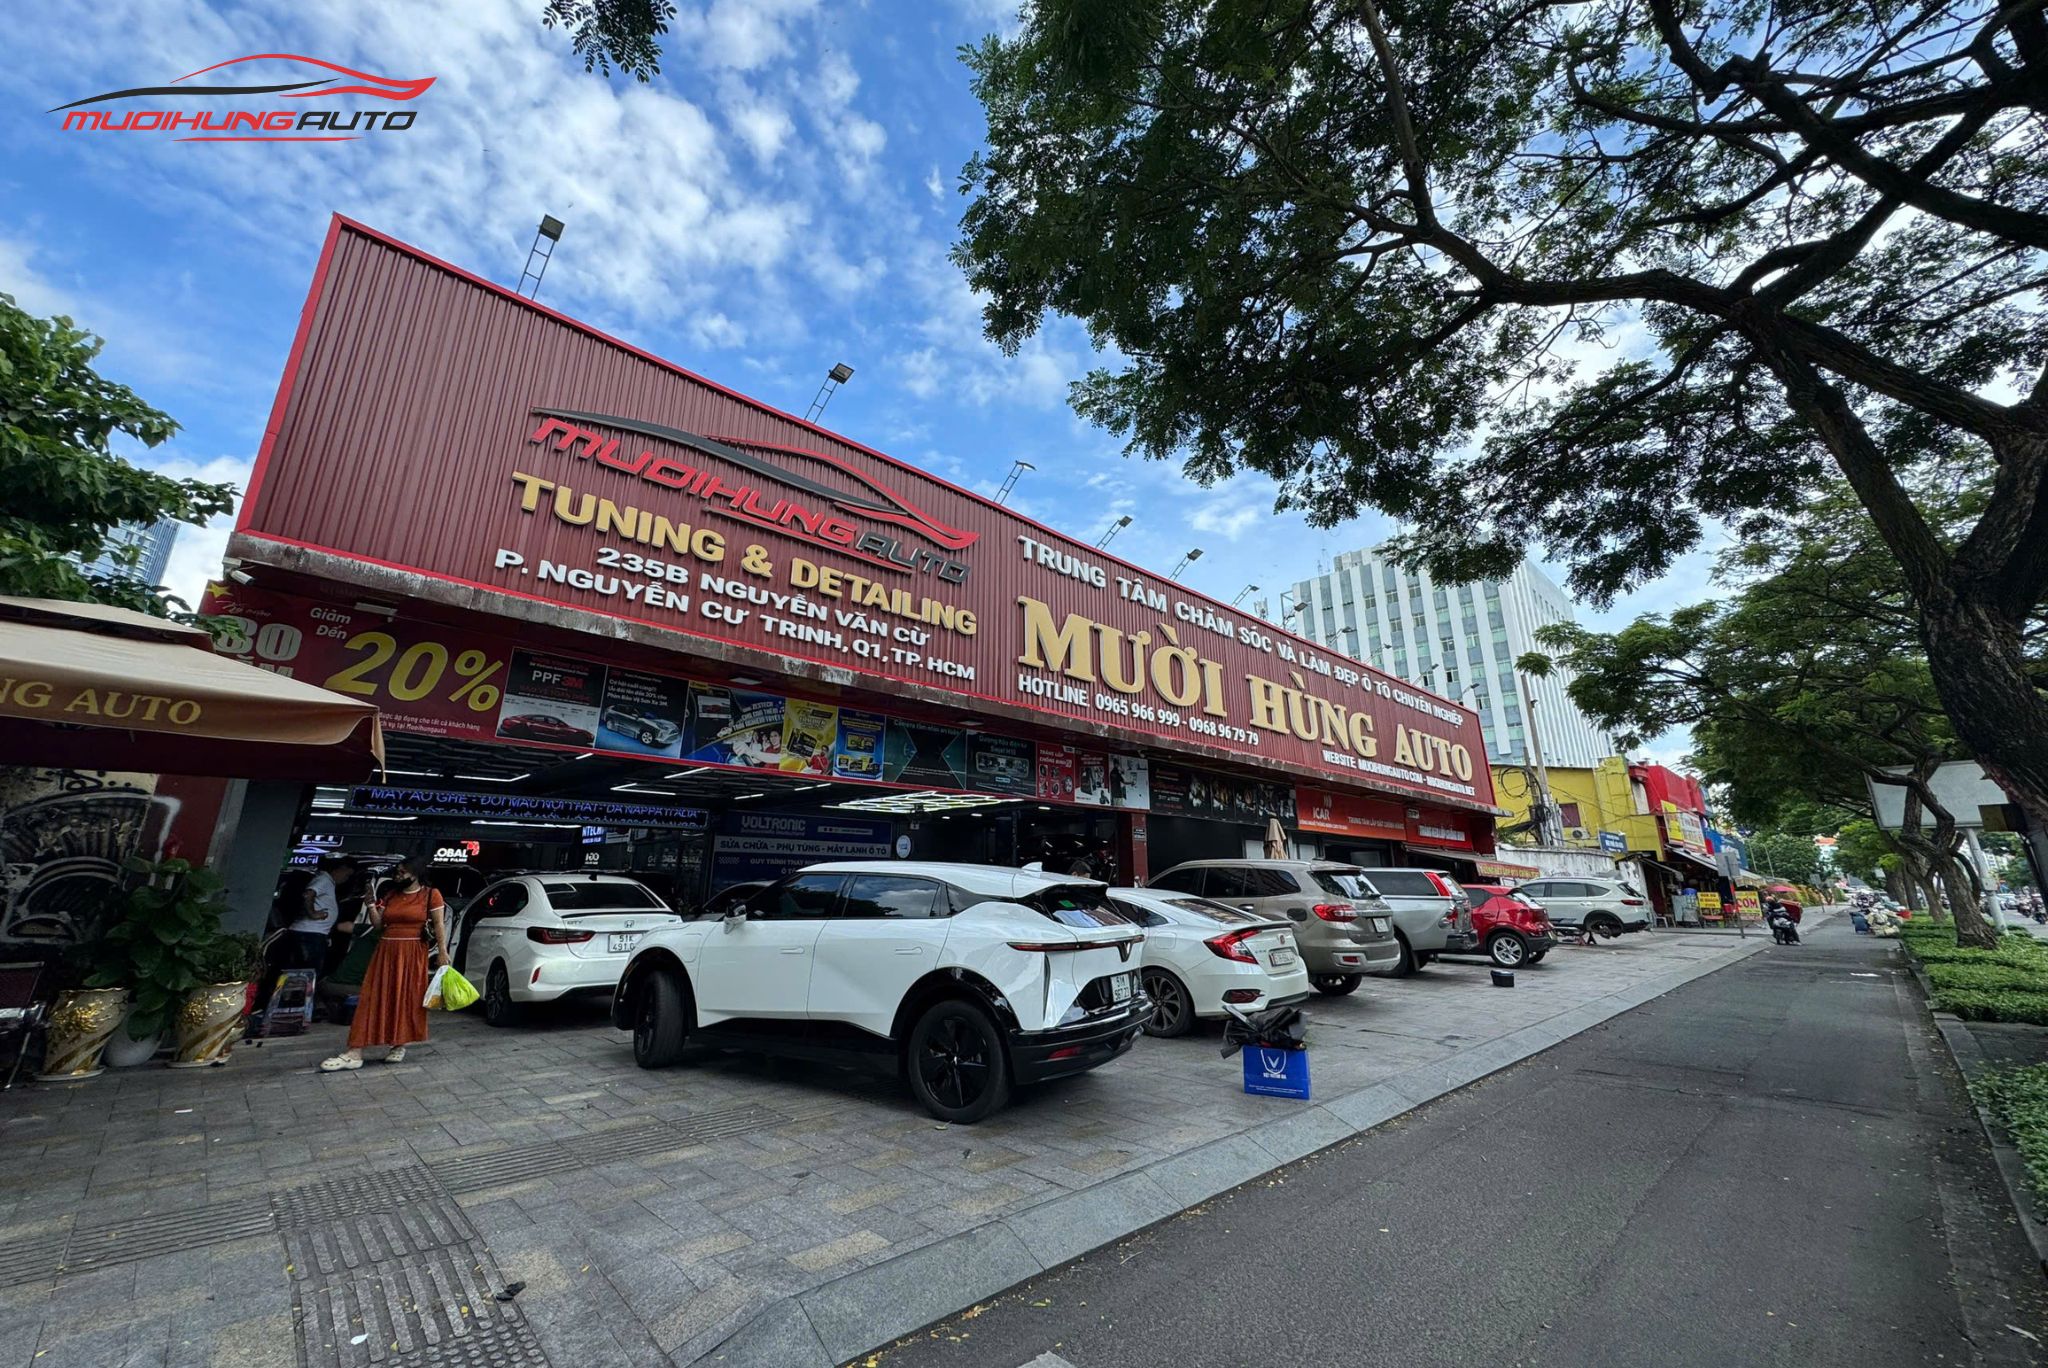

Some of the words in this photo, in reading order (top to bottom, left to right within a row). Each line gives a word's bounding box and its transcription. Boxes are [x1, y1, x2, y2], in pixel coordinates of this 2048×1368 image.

[512, 471, 727, 563] TUNING
[741, 543, 775, 580] &
[790, 556, 978, 637] DETAILING
[494, 548, 530, 575] P.
[537, 559, 690, 613] NGUYỄN
[701, 599, 750, 625] CƯ
[926, 656, 976, 681] HCM
[596, 547, 690, 585] 235B
[700, 575, 828, 622] NGUYỄN
[834, 607, 888, 635] VĂN
[1018, 535, 1106, 588] TRUNG
[1116, 577, 1168, 613] TÂM
[1174, 601, 1235, 639] CHĂM
[1238, 624, 1273, 653] SÓC
[1276, 639, 1299, 663] VÀ
[1300, 650, 1332, 676] LÀM
[1334, 665, 1359, 690] ĐẸP
[1361, 673, 1373, 692] Ô
[1375, 678, 1391, 698] TÔ
[316, 624, 348, 641] Đến
[323, 631, 503, 713] 20%
[532, 670, 562, 685] PPF
[1017, 595, 1228, 718] MƯỜI
[1246, 671, 1378, 758] HÙNG
[1393, 723, 1473, 783] AUTO
[63, 688, 202, 725] AUTO
[1095, 693, 1129, 716] 0965
[1131, 703, 1155, 722] 966
[1157, 709, 1181, 727] 999
[1189, 717, 1217, 736] 0968
[720, 837, 740, 850] SỬA
[743, 839, 769, 851] CHỮA
[741, 816, 806, 832] VOLTRONIC
